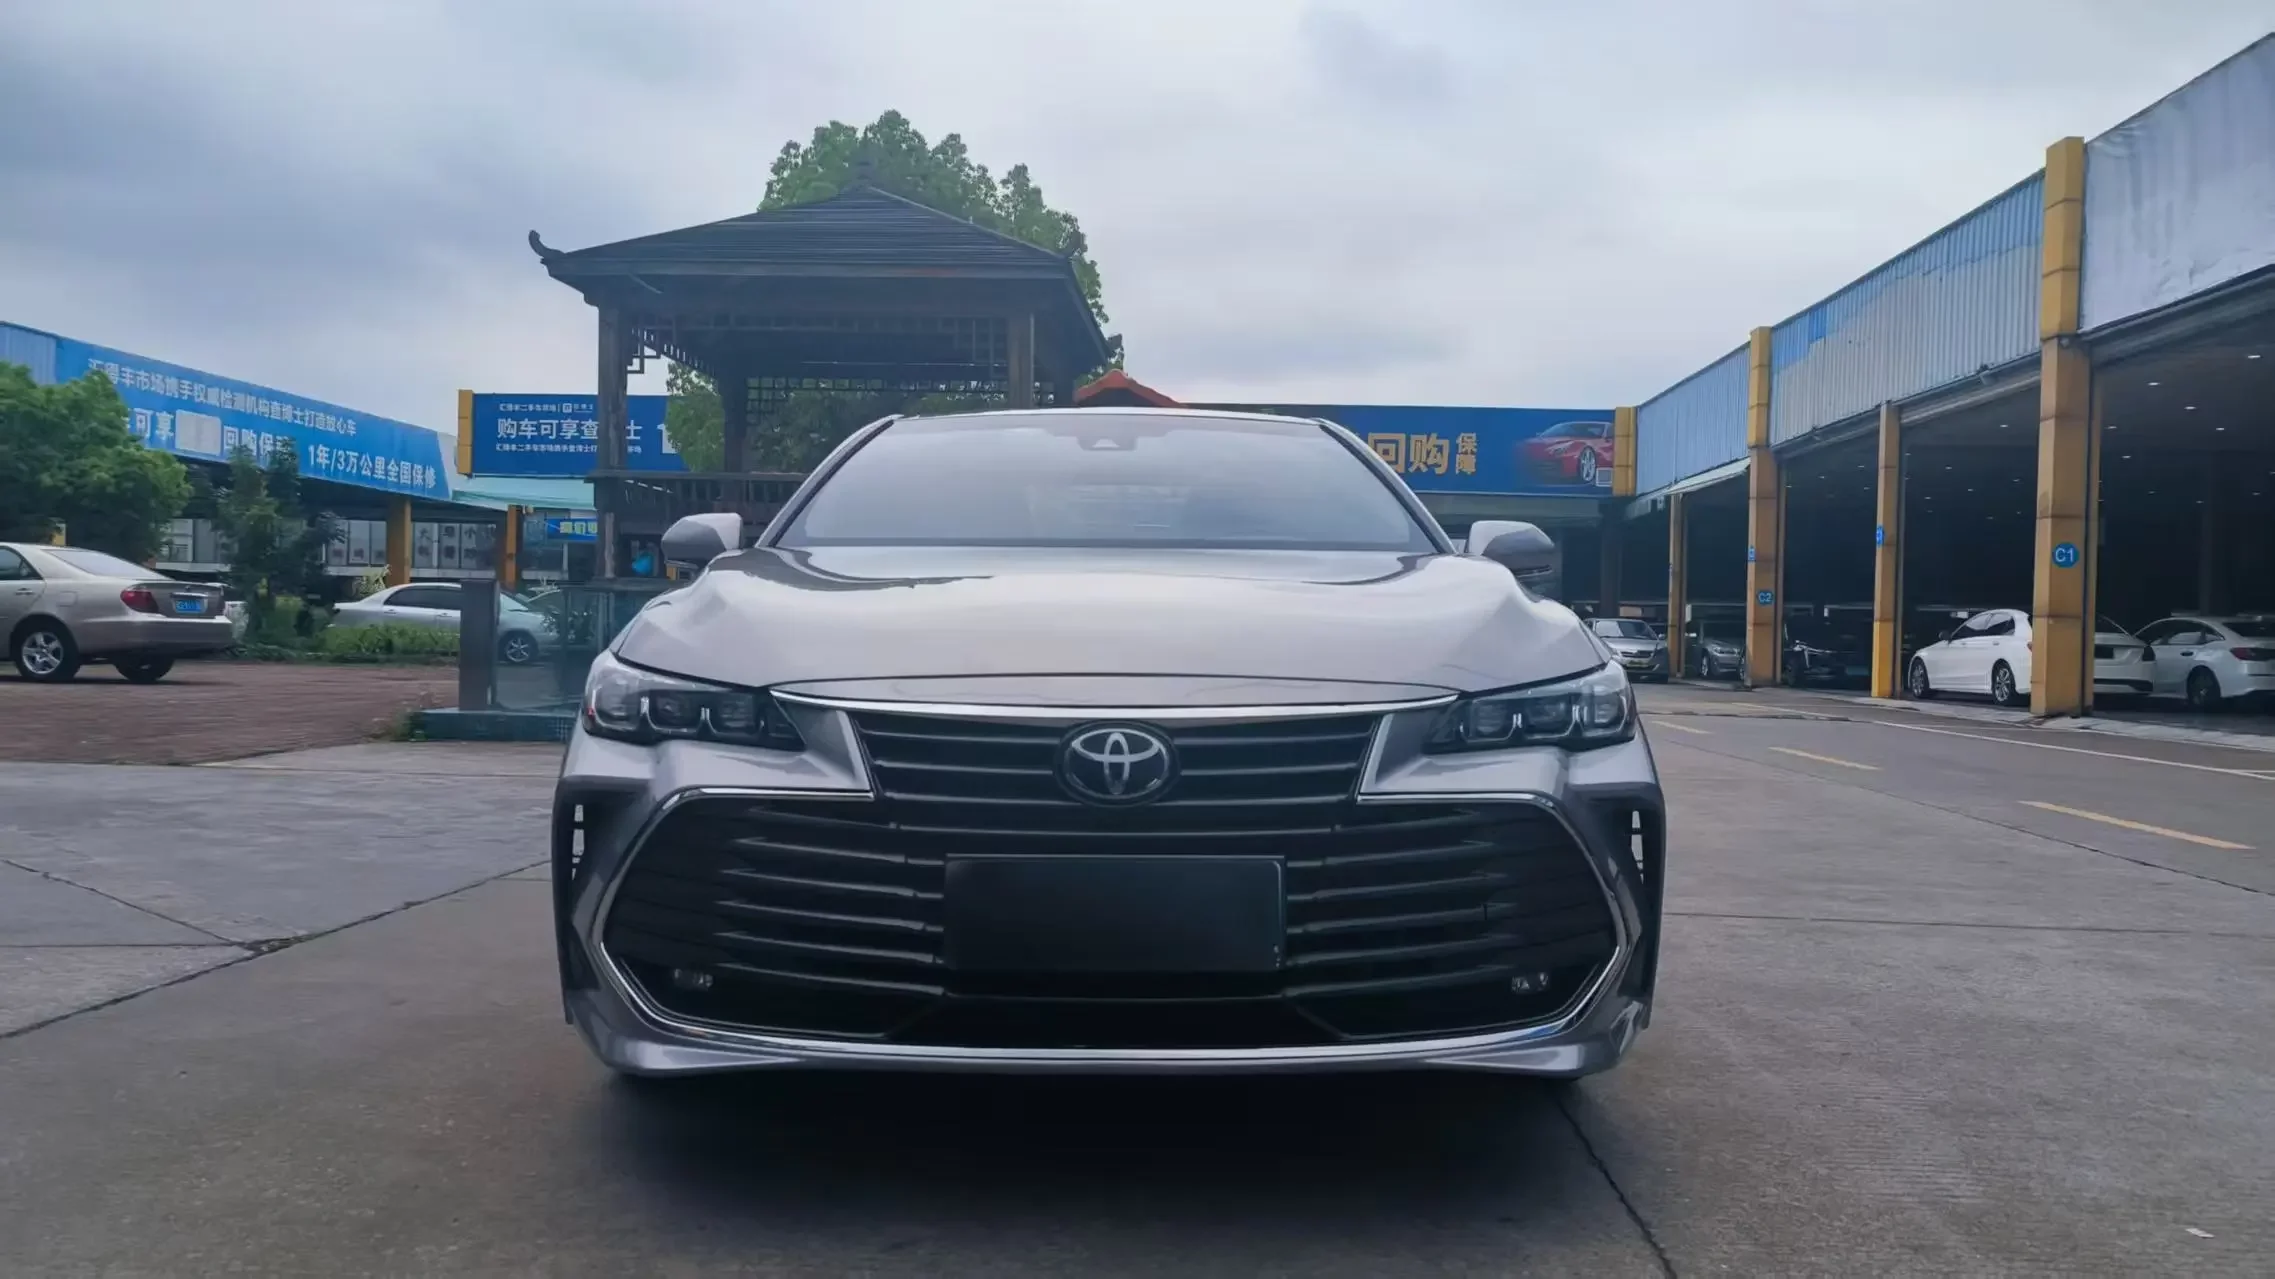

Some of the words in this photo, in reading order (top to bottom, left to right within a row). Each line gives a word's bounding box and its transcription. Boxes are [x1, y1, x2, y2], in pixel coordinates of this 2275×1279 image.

[497, 418, 643, 439] 购车可享查士
[1367, 433, 1449, 474] 回购
[307, 443, 437, 488] 1年/3万公里全国保修
[2055, 547, 2073, 562] C1
[1758, 591, 1772, 602] C2
